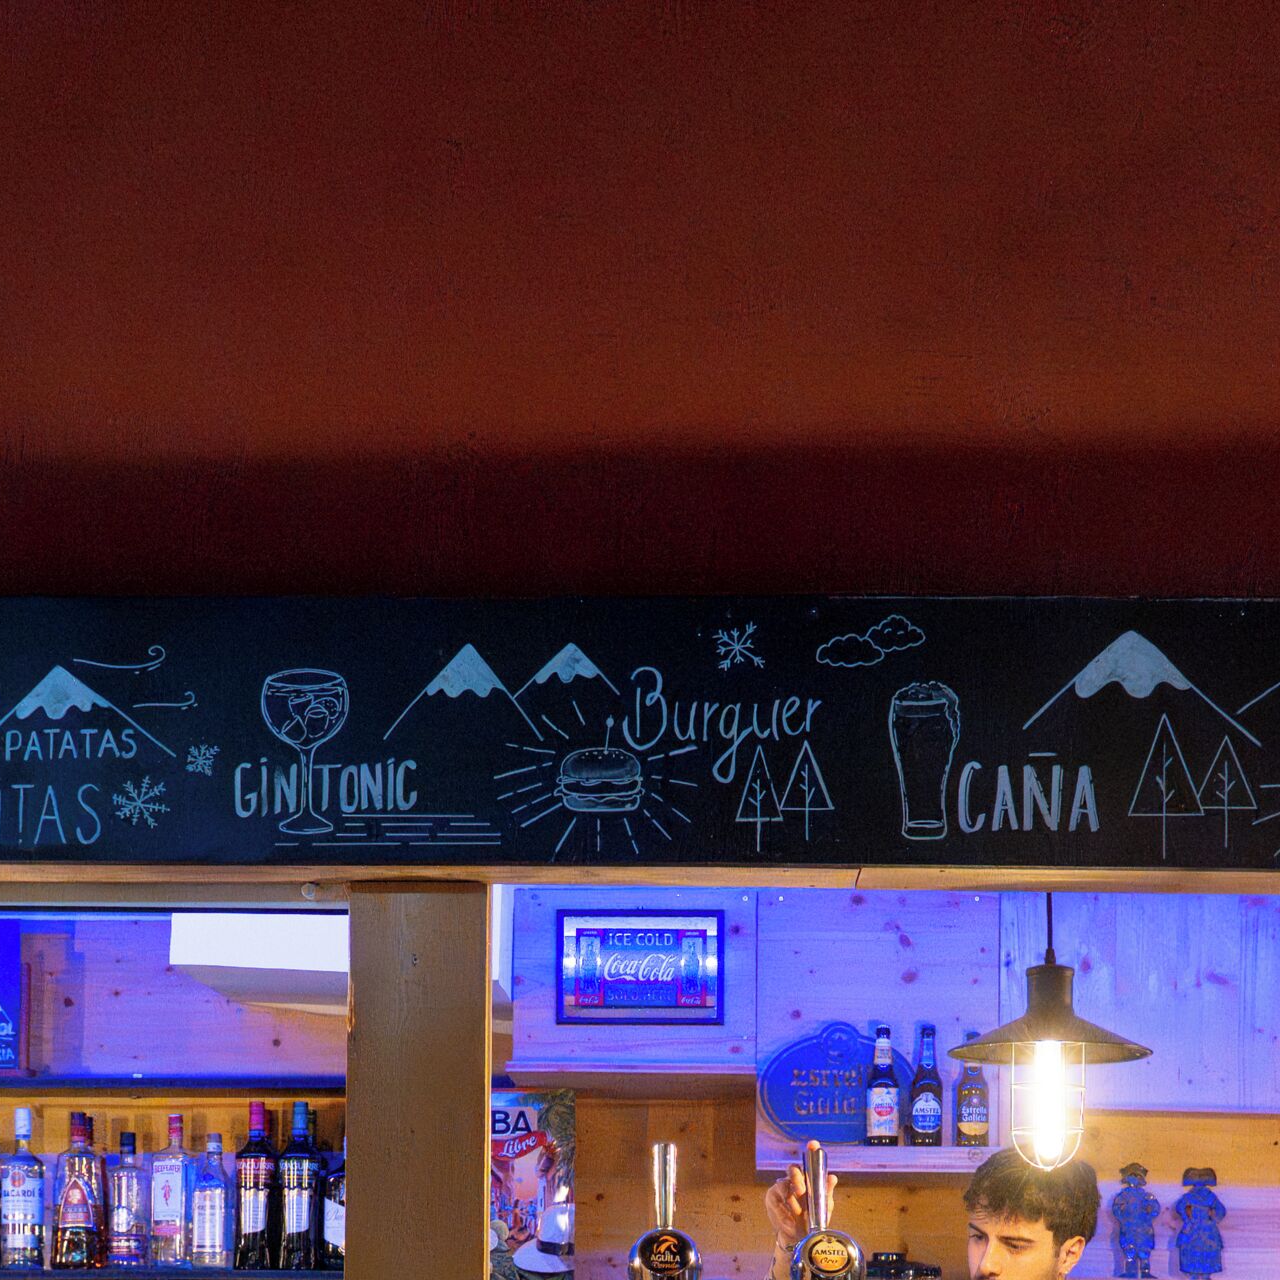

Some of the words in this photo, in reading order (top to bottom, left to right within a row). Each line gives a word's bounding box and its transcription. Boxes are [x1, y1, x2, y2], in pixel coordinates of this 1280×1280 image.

[623, 666, 822, 783] Burguer
[5, 728, 138, 762] PATATAS
[958, 752, 1101, 834] CAÑA
[609, 932, 632, 946] ICE
[635, 932, 673, 946] COLD
[603, 952, 679, 982] Coca-Cola
[498, 1133, 537, 1157] Libre
[814, 1249, 846, 1257] AMSTEL
